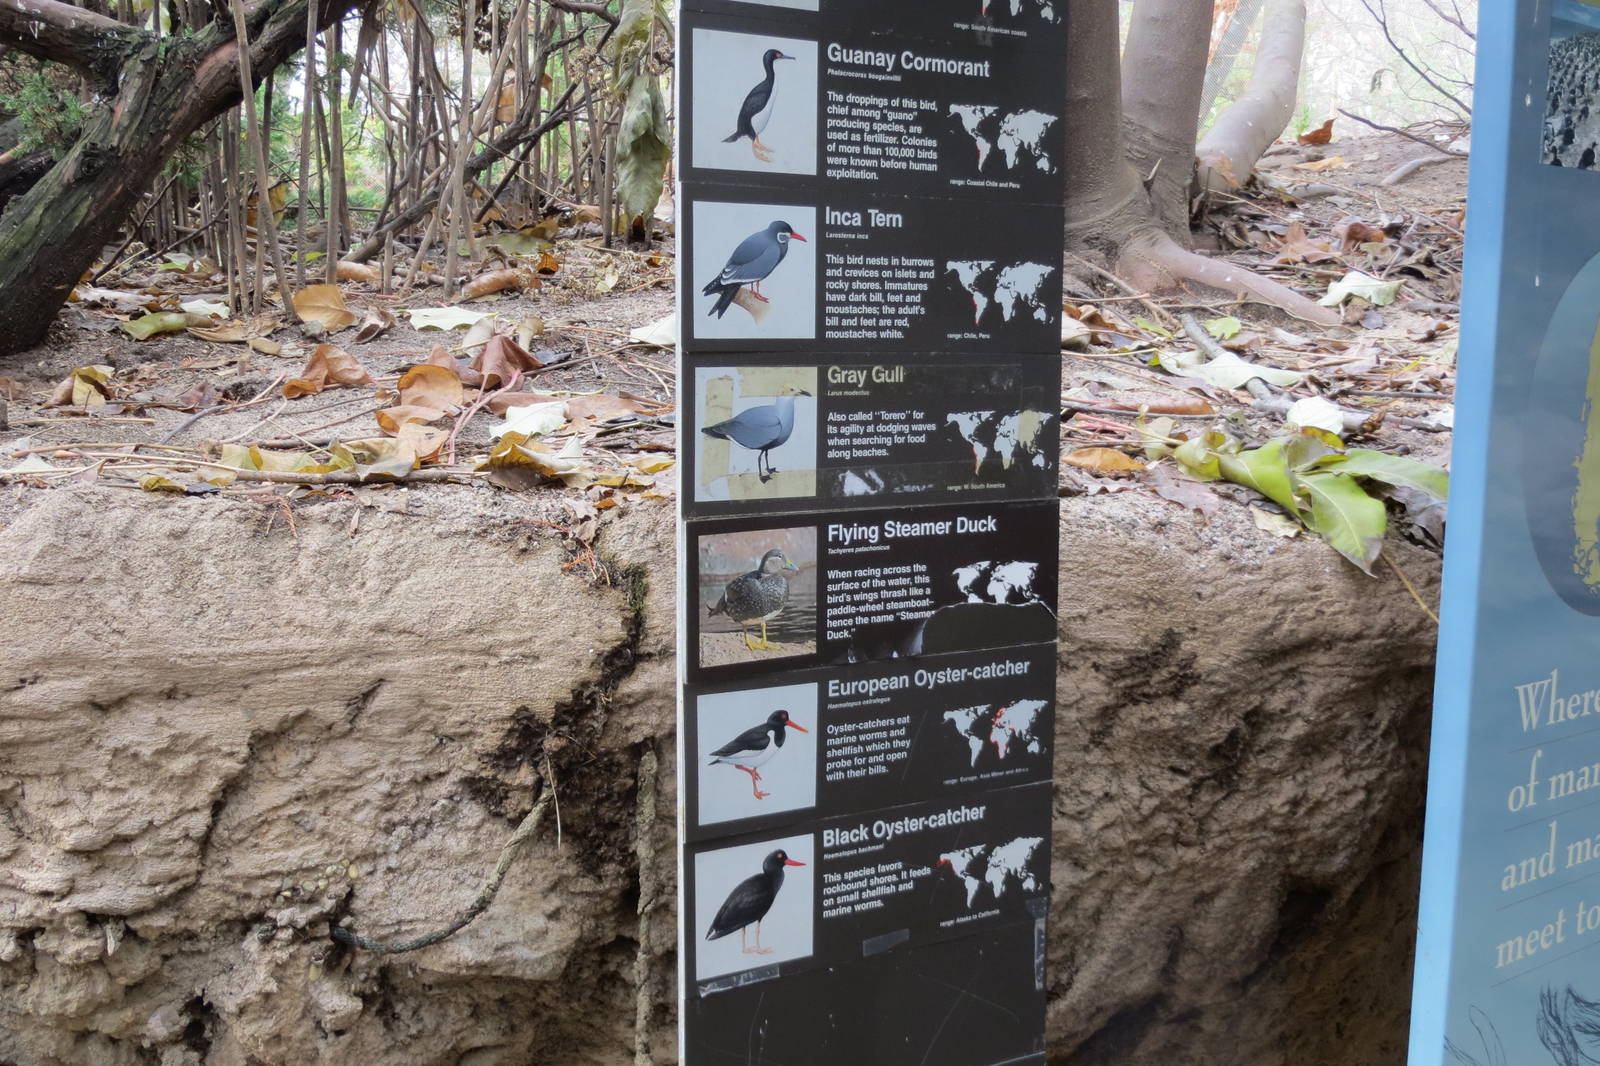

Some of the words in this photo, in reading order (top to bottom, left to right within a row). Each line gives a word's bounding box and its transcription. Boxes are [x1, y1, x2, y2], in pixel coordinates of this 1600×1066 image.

[827, 43, 896, 71] Guanay
[901, 51, 989, 77] Cormorant
[827, 91, 844, 102] The
[846, 94, 888, 107] droppings
[891, 98, 900, 106] of
[902, 99, 917, 108] this
[920, 100, 937, 111] bird,
[827, 105, 849, 115] chief
[852, 108, 880, 119] among
[827, 118, 869, 132] producing
[872, 122, 906, 133] species,
[909, 125, 922, 134] are
[827, 131, 847, 140] used
[851, 133, 861, 141] as
[864, 133, 899, 144] fertilizer.
[902, 136, 937, 147] Colonies
[827, 144, 836, 152] of
[838, 145, 860, 154] more
[863, 146, 881, 155] than
[885, 147, 914, 158] 100,000
[917, 149, 937, 159] birds
[827, 157, 847, 165] were
[850, 158, 878, 167] known
[881, 159, 906, 169] before
[909, 161, 937, 171] human
[827, 168, 878, 180] exploitation.
[826, 206, 861, 226] Inca
[868, 209, 902, 227] Tern
[826, 255, 844, 264] This
[847, 255, 863, 265] bird
[866, 257, 888, 265] nests
[891, 256, 899, 265] in
[902, 256, 934, 266] burrows
[826, 268, 842, 277] and
[845, 268, 879, 277] crevices
[882, 270, 892, 278] on
[895, 269, 916, 278] islets
[919, 269, 934, 279] and
[826, 281, 849, 291] rocky
[852, 281, 881, 290] shores.
[885, 281, 928, 291] Immatures
[826, 293, 846, 302] have
[849, 293, 867, 302] dark
[869, 293, 884, 303] bill,
[887, 293, 903, 302] feet
[906, 293, 920, 302] and
[826, 305, 879, 316] moustaches;
[882, 306, 895, 314] the
[898, 306, 925, 315] adult's
[826, 317, 838, 326] bill
[841, 317, 857, 326] and
[860, 317, 876, 326] feet
[894, 317, 909, 328] red,
[826, 329, 877, 338] moustaches
[880, 329, 904, 338] white.
[828, 366, 867, 387] Gray
[872, 366, 903, 383] Gull
[828, 412, 846, 421] Also
[848, 412, 872, 421] called
[913, 411, 924, 419] for
[828, 425, 837, 434] its
[840, 423, 864, 435] agility
[867, 424, 874, 432] at
[876, 423, 909, 434] dodging
[911, 423, 936, 431] waves
[828, 437, 850, 446] when
[852, 435, 891, 446] searching
[894, 435, 905, 444] for
[907, 434, 925, 443] food
[828, 449, 850, 460] along
[852, 447, 888, 457] beaches.
[828, 523, 879, 545] Flying
[884, 519, 951, 537] Steamer
[956, 515, 997, 533] Duck
[828, 569, 852, 579] When
[854, 567, 880, 578] racing
[883, 566, 911, 575] across
[913, 564, 926, 572] the
[827, 580, 859, 592] surface
[862, 579, 870, 589] of
[872, 578, 885, 587] the
[888, 577, 912, 587] water,
[914, 575, 929, 583] this
[828, 593, 851, 604] bird's
[853, 590, 878, 603] wings
[881, 588, 907, 598] thrash
[909, 587, 923, 596] like
[827, 603, 884, 617] paddle-wheel
[827, 618, 853, 628] hence
[855, 615, 868, 625] the
[871, 614, 894, 623] name
[828, 674, 909, 697] European
[914, 659, 1030, 689] Oyster-catcher
[827, 717, 894, 735] Oyster-catchers
[897, 714, 910, 724] eat
[827, 734, 856, 746] marine
[859, 730, 887, 741] worms
[890, 727, 905, 737] and
[826, 745, 863, 757] shellfish
[866, 741, 890, 753] which
[893, 738, 910, 750] they
[826, 759, 852, 771] probe
[854, 755, 866, 766] for
[868, 754, 884, 764] and
[886, 752, 907, 762] open
[826, 771, 844, 781] with
[847, 767, 866, 778] their
[869, 764, 888, 775] bills.
[1507, 749, 1542, 813] of
[823, 824, 868, 848] Black
[873, 805, 986, 841] Oyster-catcher
[1501, 820, 1556, 891] and
[823, 880, 867, 895] rockbound
[870, 874, 898, 886] shores.
[901, 870, 907, 879] It
[910, 866, 931, 878] feeds
[824, 873, 841, 884] This
[844, 867, 875, 881] species
[878, 862, 902, 873] favors
[823, 899, 833, 907] on
[836, 892, 859, 904] small
[862, 885, 895, 900] shellfish
[898, 881, 913, 891] and
[823, 907, 852, 918] marine
[854, 900, 884, 912] worms.
[1494, 908, 1567, 969] meet
[1576, 900, 1600, 937] to
